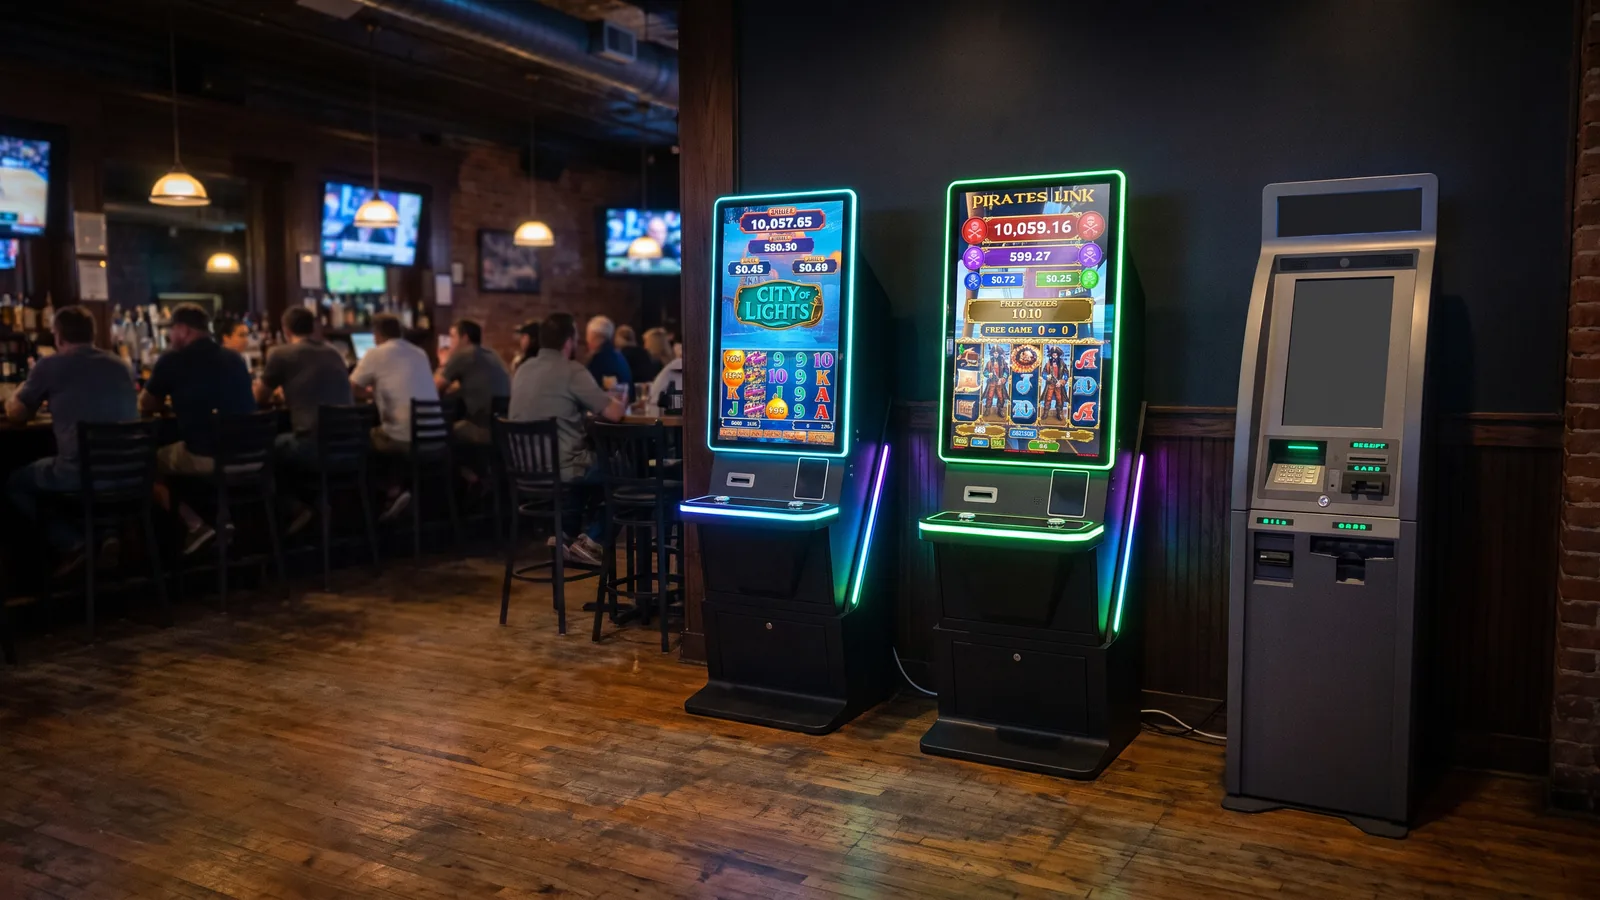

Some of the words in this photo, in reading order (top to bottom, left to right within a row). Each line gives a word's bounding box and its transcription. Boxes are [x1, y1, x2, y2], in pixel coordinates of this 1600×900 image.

[972, 191, 1048, 209] PIRATES
[1054, 188, 1095, 203] LINK
[751, 217, 812, 231] 10,057.65
[994, 220, 1072, 237] 10,059.16
[764, 242, 797, 252] 580.30
[1009, 251, 1051, 262] 599.27
[735, 264, 764, 274] $0.45
[799, 263, 828, 273] $0.69
[991, 276, 1016, 284] $0.72
[1046, 274, 1072, 283] $0.25
[756, 286, 800, 303] CITY
[800, 291, 811, 300] OF
[745, 301, 810, 320] LIGHTS
[1000, 300, 1023, 308] FREE
[985, 326, 1006, 334] FREE
[1008, 326, 1033, 334] GAME
[773, 352, 785, 367] 9
[795, 352, 808, 368] 9
[813, 352, 834, 368] 10
[768, 368, 788, 384] 10
[794, 369, 807, 385] 9
[815, 369, 831, 386] K
[726, 386, 740, 400] K
[794, 386, 806, 402] 9
[815, 386, 831, 402] A
[727, 401, 739, 416] J
[793, 403, 806, 419] 9
[814, 404, 830, 420] A
